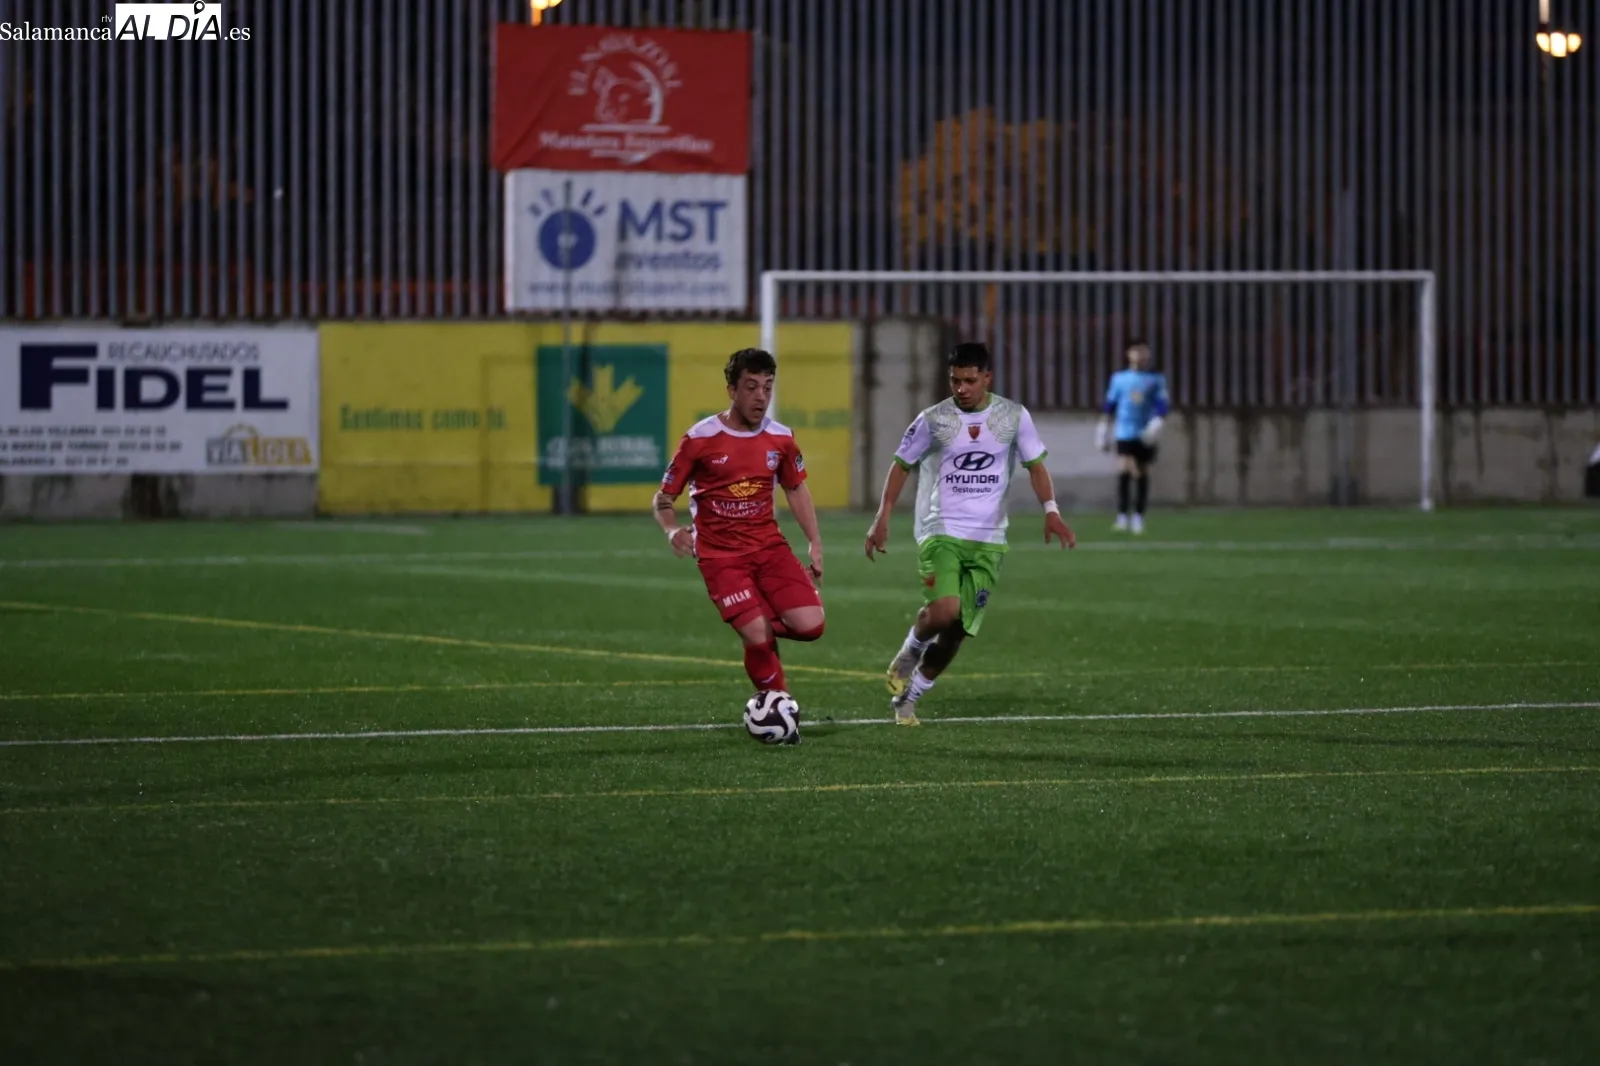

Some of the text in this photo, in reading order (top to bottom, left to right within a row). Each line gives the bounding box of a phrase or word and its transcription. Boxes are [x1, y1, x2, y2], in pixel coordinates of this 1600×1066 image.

[618, 199, 728, 245] MST
[616, 250, 722, 272] eventos
[107, 341, 260, 363] RECAUCHUTADOS
[19, 342, 289, 412] FIDEL
[945, 474, 999, 484] HYUNDAI
[723, 589, 751, 607] MILAR
